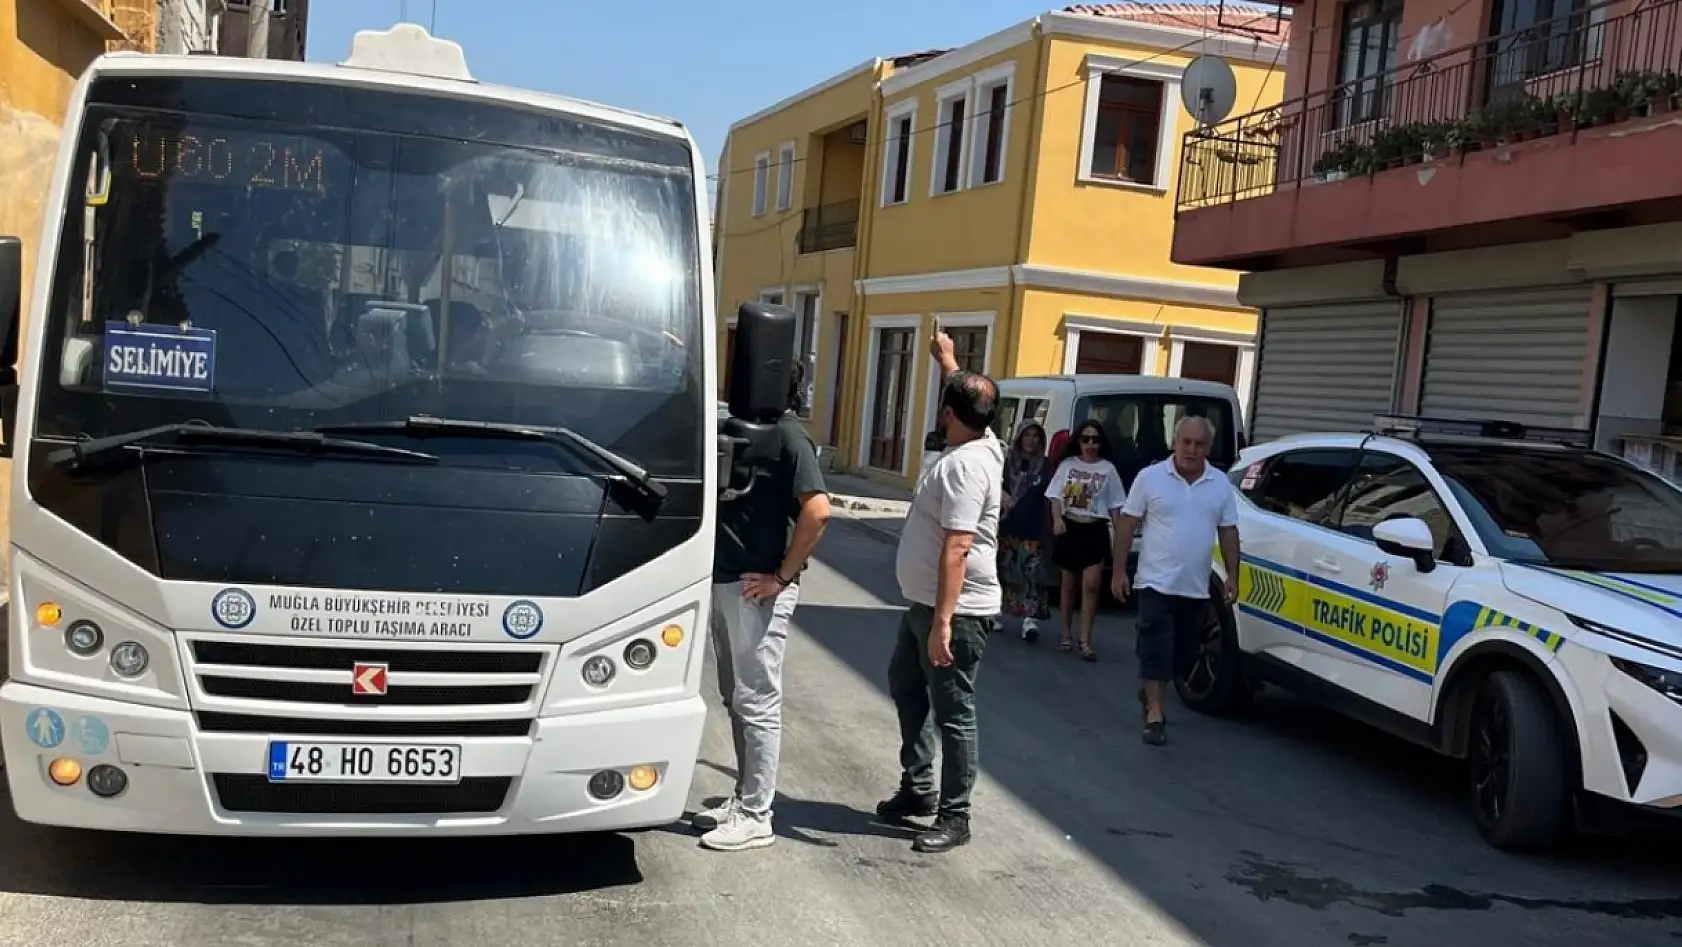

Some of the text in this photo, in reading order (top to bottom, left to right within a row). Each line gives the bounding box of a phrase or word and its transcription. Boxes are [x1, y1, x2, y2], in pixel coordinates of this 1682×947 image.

[109, 342, 208, 379] SELİMİYE
[269, 593, 320, 611] MUĞLA
[324, 595, 410, 616] BÜYÜKŞEHİR
[291, 613, 471, 638] ÖZEL TOPLU TAŞIMA ARACI
[1312, 598, 1429, 660] TRAFİK POLİSİ
[290, 746, 454, 777] 48 HO 6653
